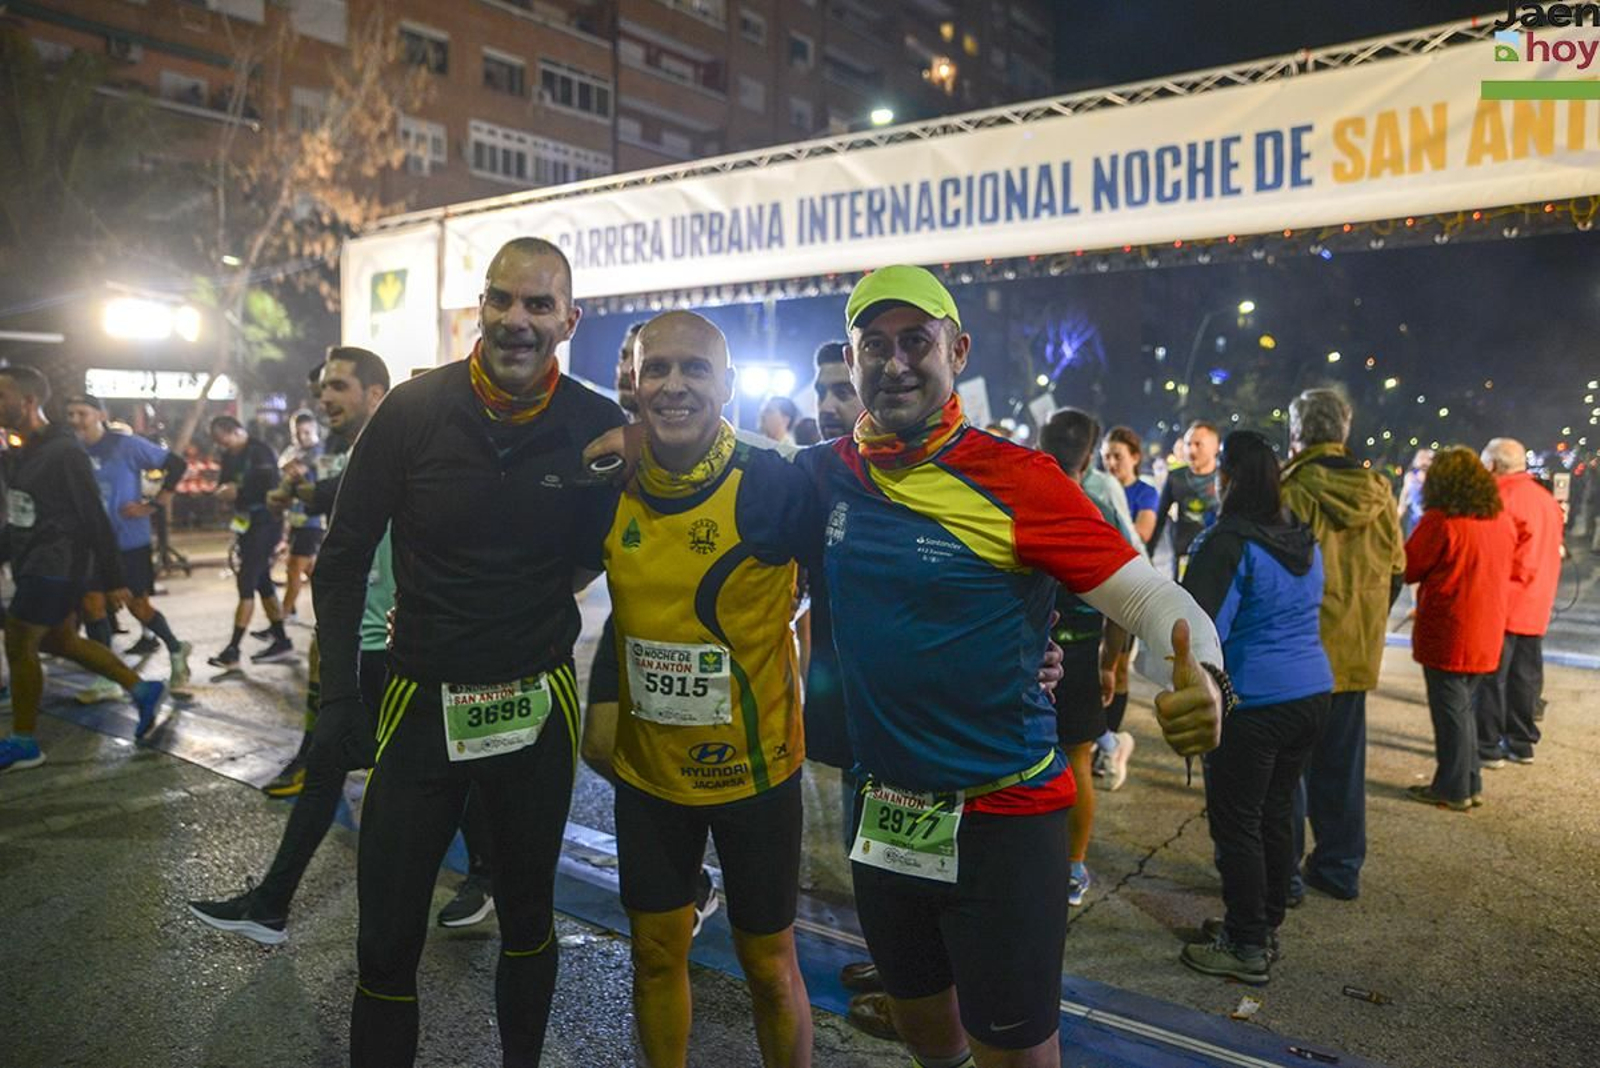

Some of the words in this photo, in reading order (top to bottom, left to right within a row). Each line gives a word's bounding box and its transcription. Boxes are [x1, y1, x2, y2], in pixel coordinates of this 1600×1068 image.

[559, 217, 665, 270] CARRERA
[671, 201, 785, 259] URBANA
[795, 160, 1080, 247] INTERNACIONAL
[1093, 135, 1242, 213] NOCHE
[1254, 124, 1314, 193] DE
[1331, 101, 1449, 184] SAN
[1466, 98, 1600, 167] ANT
[644, 649, 677, 662] NOCHE
[678, 652, 692, 662] DE
[645, 672, 709, 698] 5915
[455, 693, 476, 705] SAN
[467, 697, 532, 728] 3698
[681, 762, 749, 778] HYUNDAI
[873, 788, 890, 802] SAN
[878, 805, 941, 840] 2977
